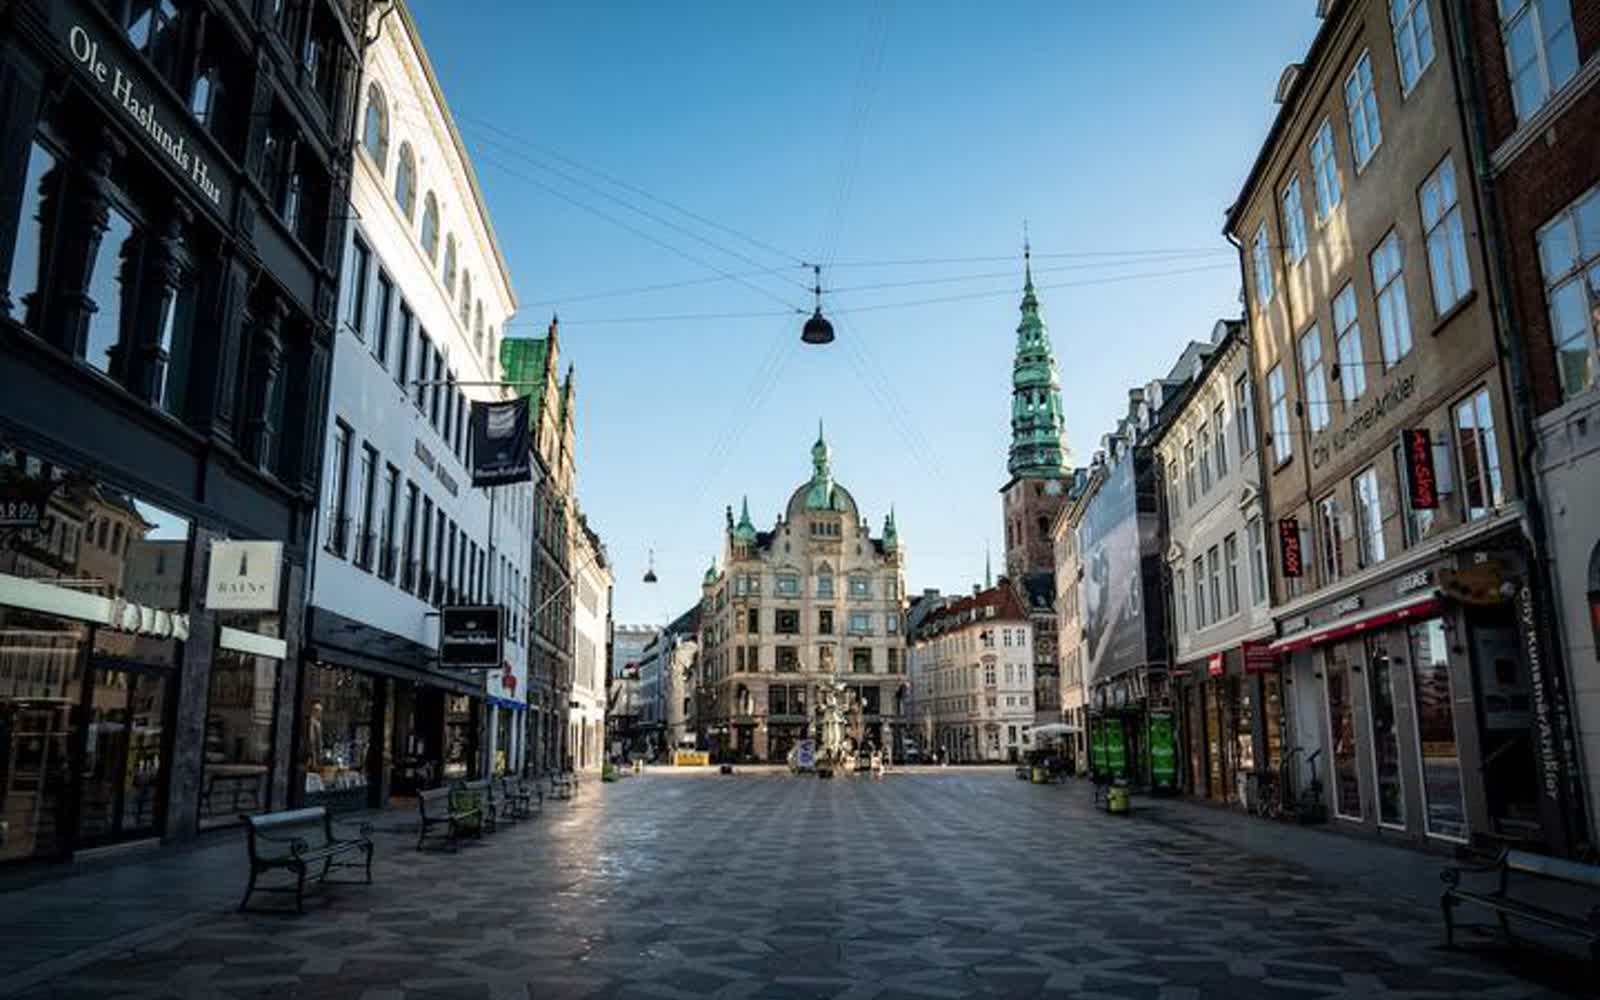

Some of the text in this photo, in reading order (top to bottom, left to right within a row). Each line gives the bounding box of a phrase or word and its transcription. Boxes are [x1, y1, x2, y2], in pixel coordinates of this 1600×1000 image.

[70, 25, 221, 204] Ole Haslunds Hus
